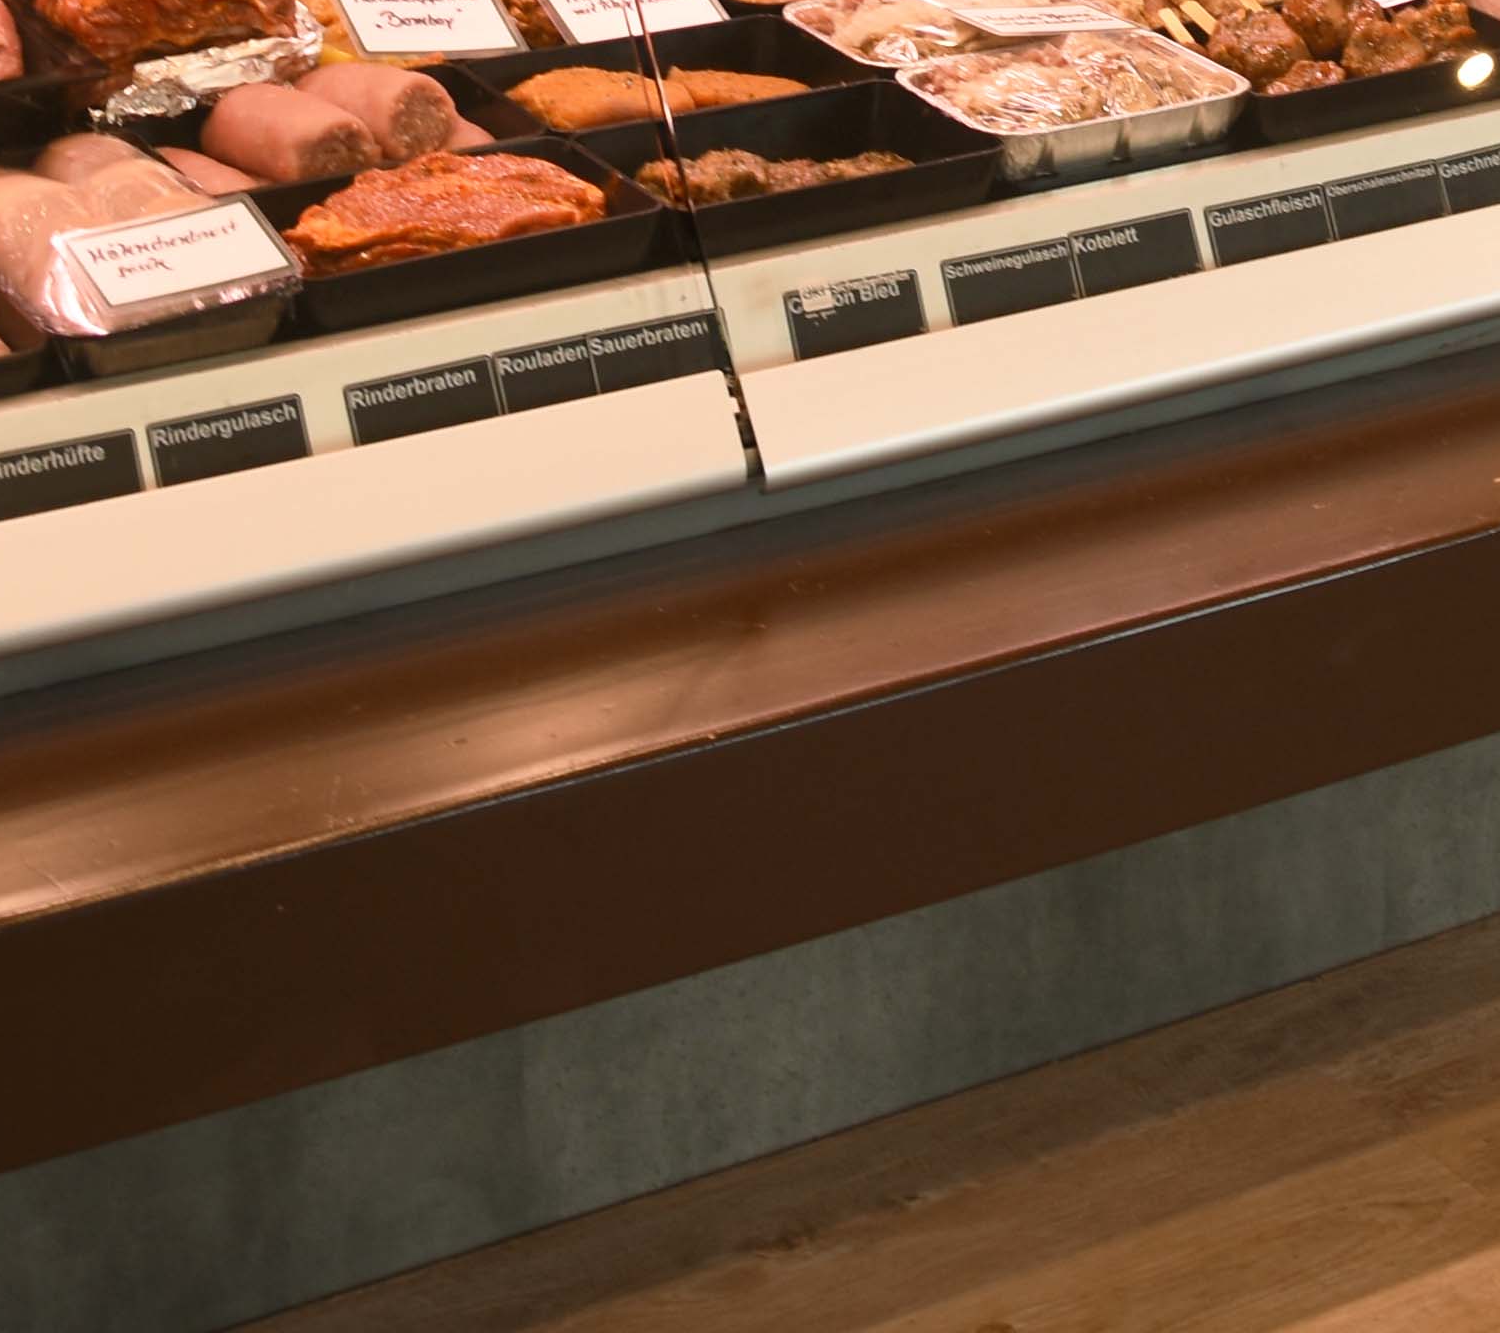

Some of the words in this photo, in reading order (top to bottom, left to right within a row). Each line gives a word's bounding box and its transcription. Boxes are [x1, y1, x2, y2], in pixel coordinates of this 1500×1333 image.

[1209, 191, 1323, 231] Gulaschfleisch
[1072, 225, 1139, 255] Kotelett
[945, 242, 1069, 281] Schweinegulasch
[789, 290, 856, 315] Con
[859, 283, 901, 302] Bleu
[589, 319, 705, 357] Sauerbraten
[498, 344, 588, 376] Rouladen
[348, 367, 478, 412] Rinderbraten
[151, 401, 298, 452] Rindergulasch
